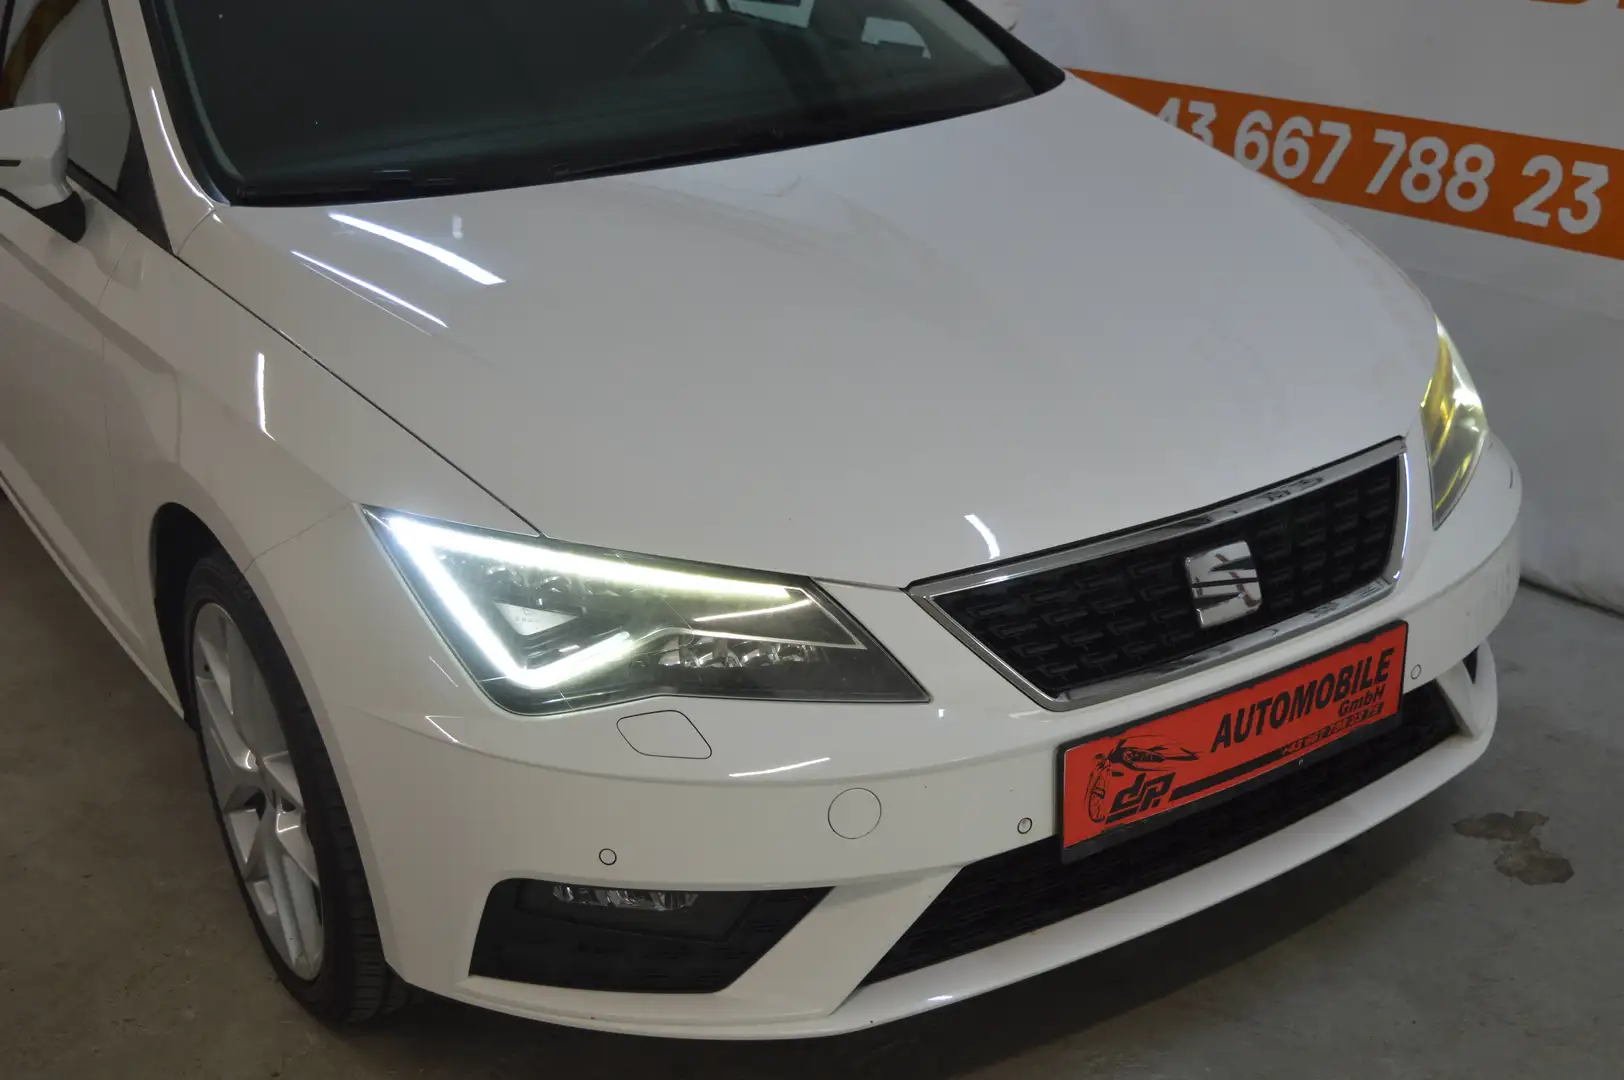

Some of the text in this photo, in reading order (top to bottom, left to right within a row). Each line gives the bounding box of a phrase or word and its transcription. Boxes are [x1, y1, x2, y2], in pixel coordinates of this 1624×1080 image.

[1234, 110, 1352, 185] 667
[1365, 129, 1496, 212] 788
[1513, 154, 1610, 235] 23
[1210, 647, 1396, 753] AUTOMOBILE
[1338, 684, 1387, 717] GmbH
